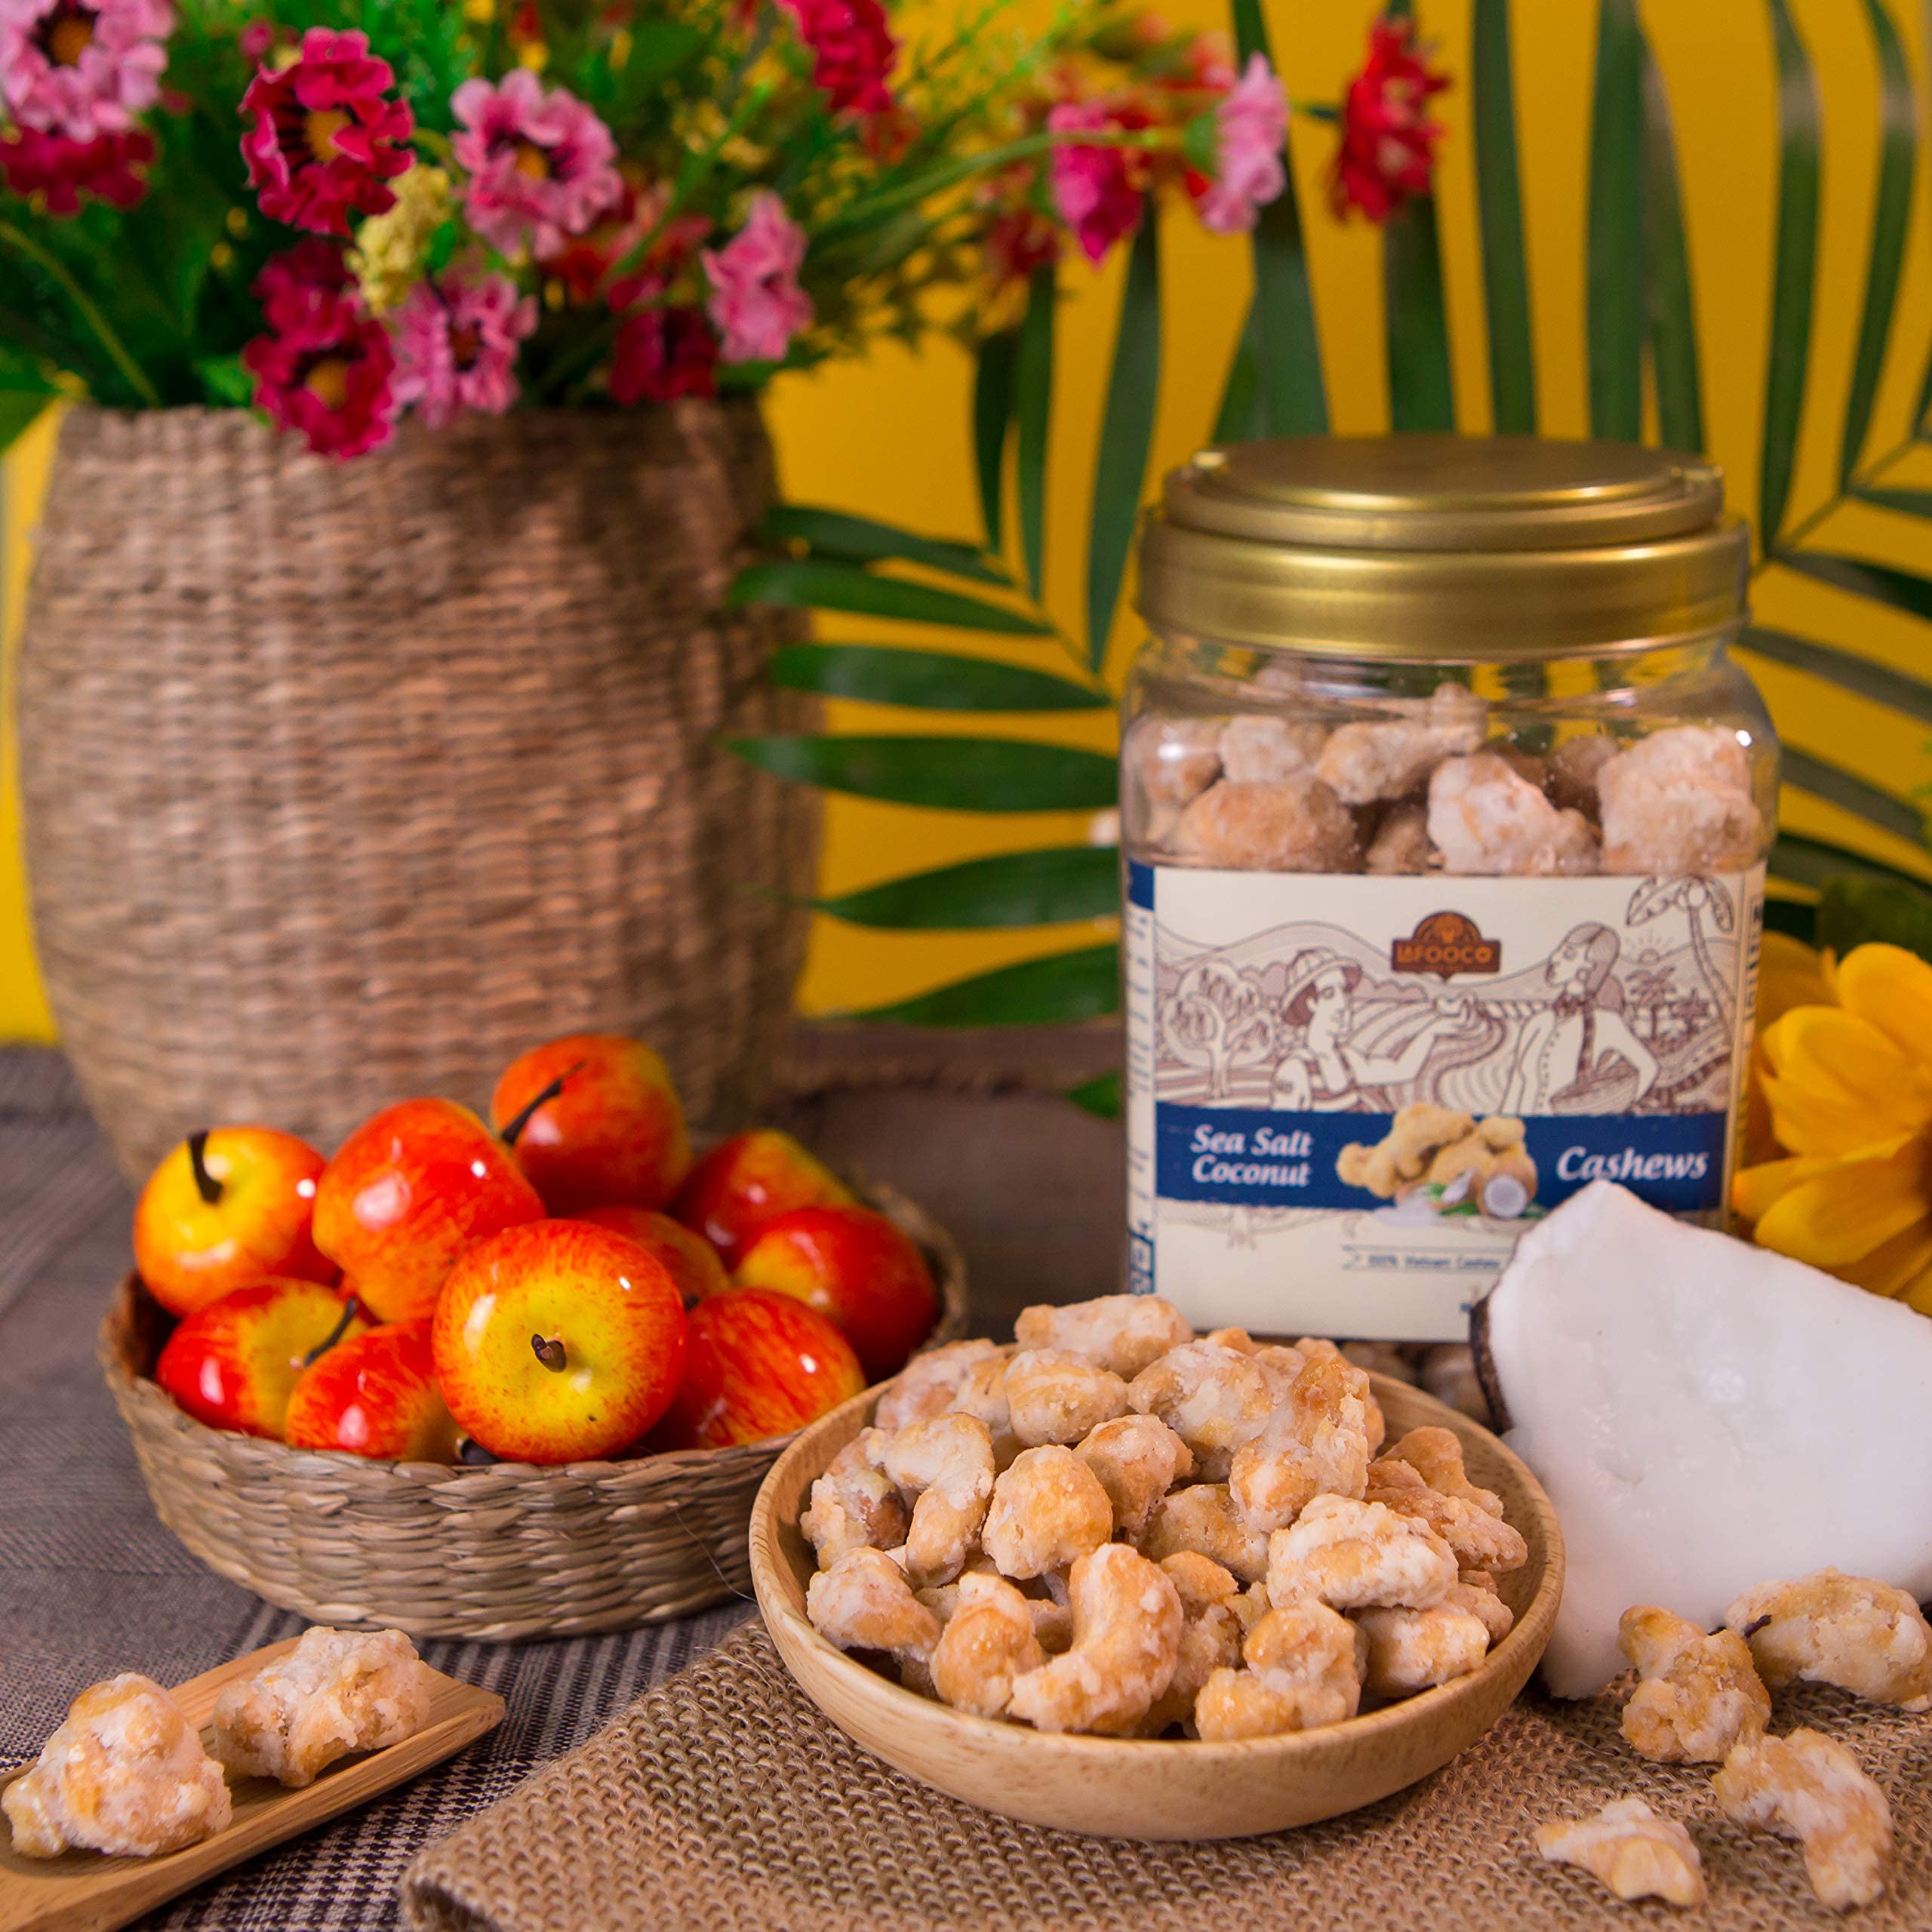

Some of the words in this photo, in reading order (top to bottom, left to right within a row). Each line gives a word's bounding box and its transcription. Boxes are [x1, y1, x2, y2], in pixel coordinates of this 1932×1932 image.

[1190, 1124, 1245, 1154] Sea
[1251, 1126, 1313, 1158] Salt
[1192, 1154, 1311, 1187] Coconut
[1556, 1146, 1709, 1180] Cashews
